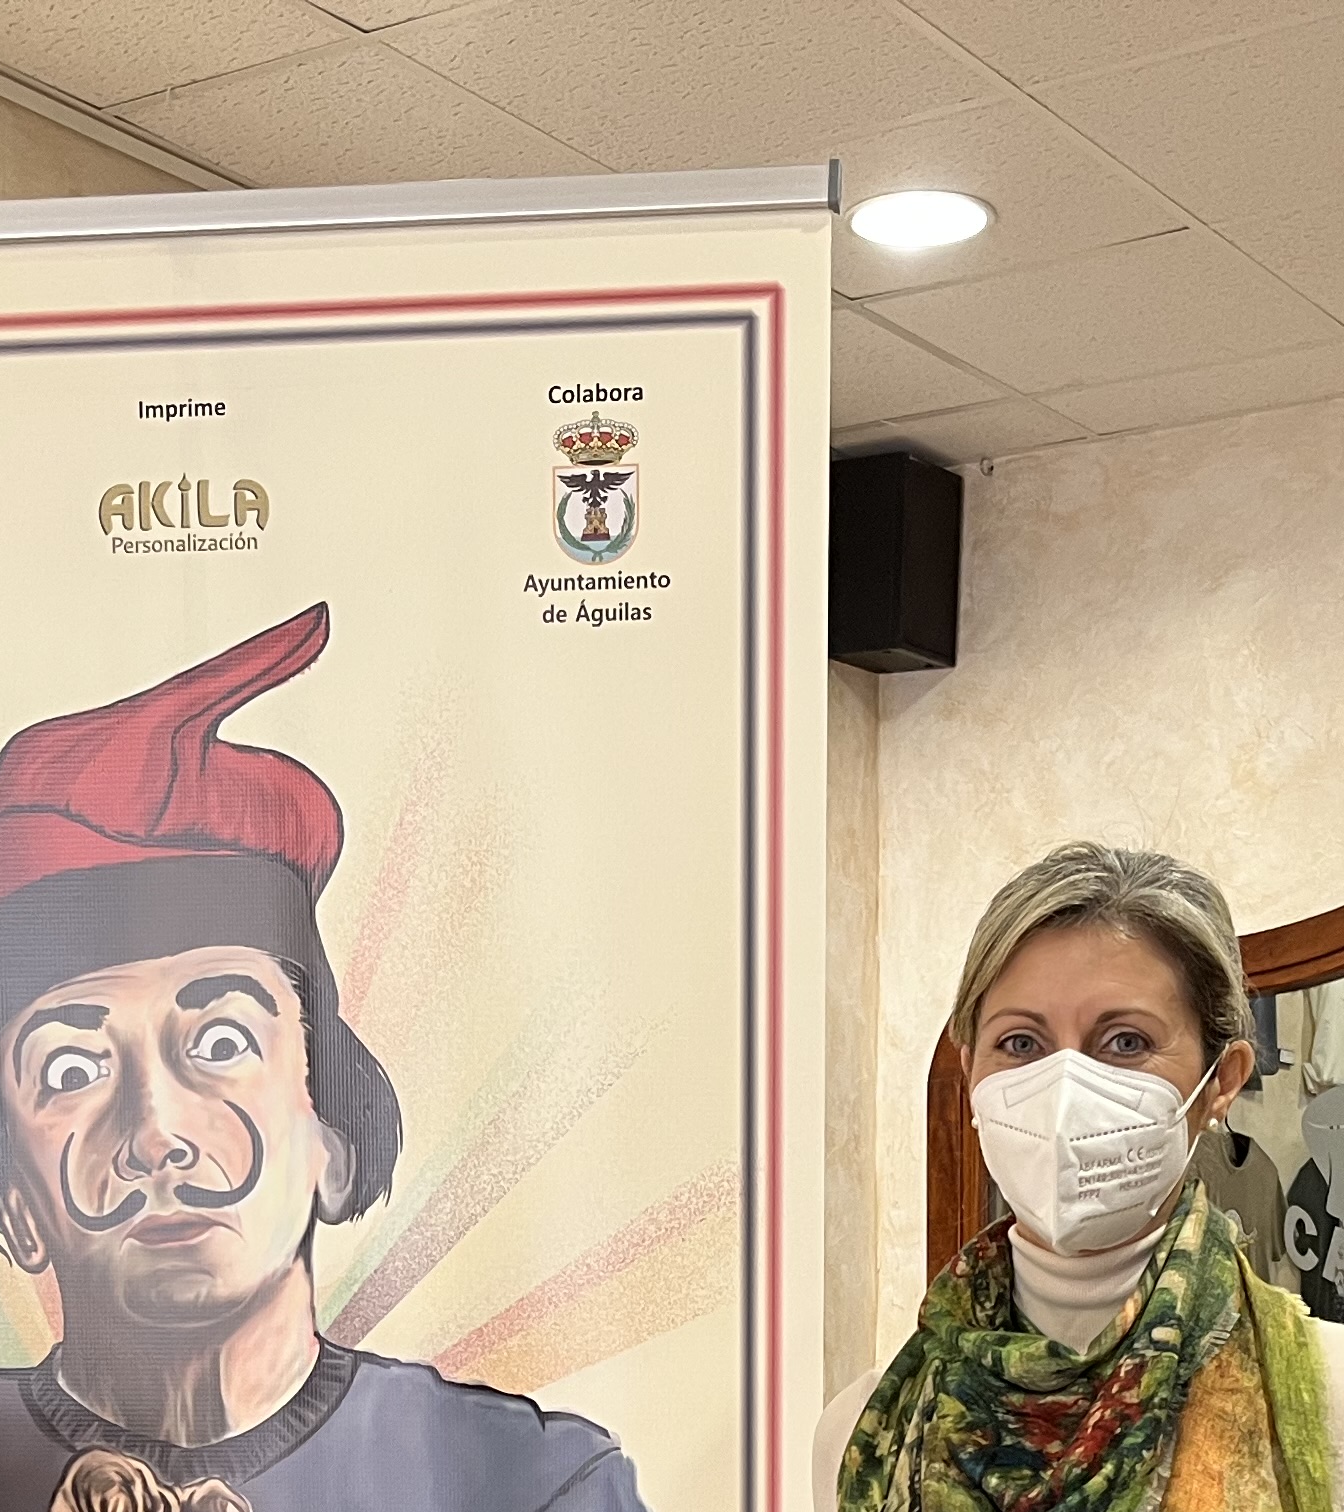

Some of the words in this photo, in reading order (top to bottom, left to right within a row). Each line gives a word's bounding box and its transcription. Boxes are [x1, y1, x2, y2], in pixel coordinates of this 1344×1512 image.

[548, 383, 644, 404] Colabora
[139, 398, 226, 422] Imprime
[112, 531, 258, 554] Personalización
[524, 570, 671, 598] Ayuntamiento
[542, 604, 567, 623] de
[576, 599, 652, 627] Águilas
